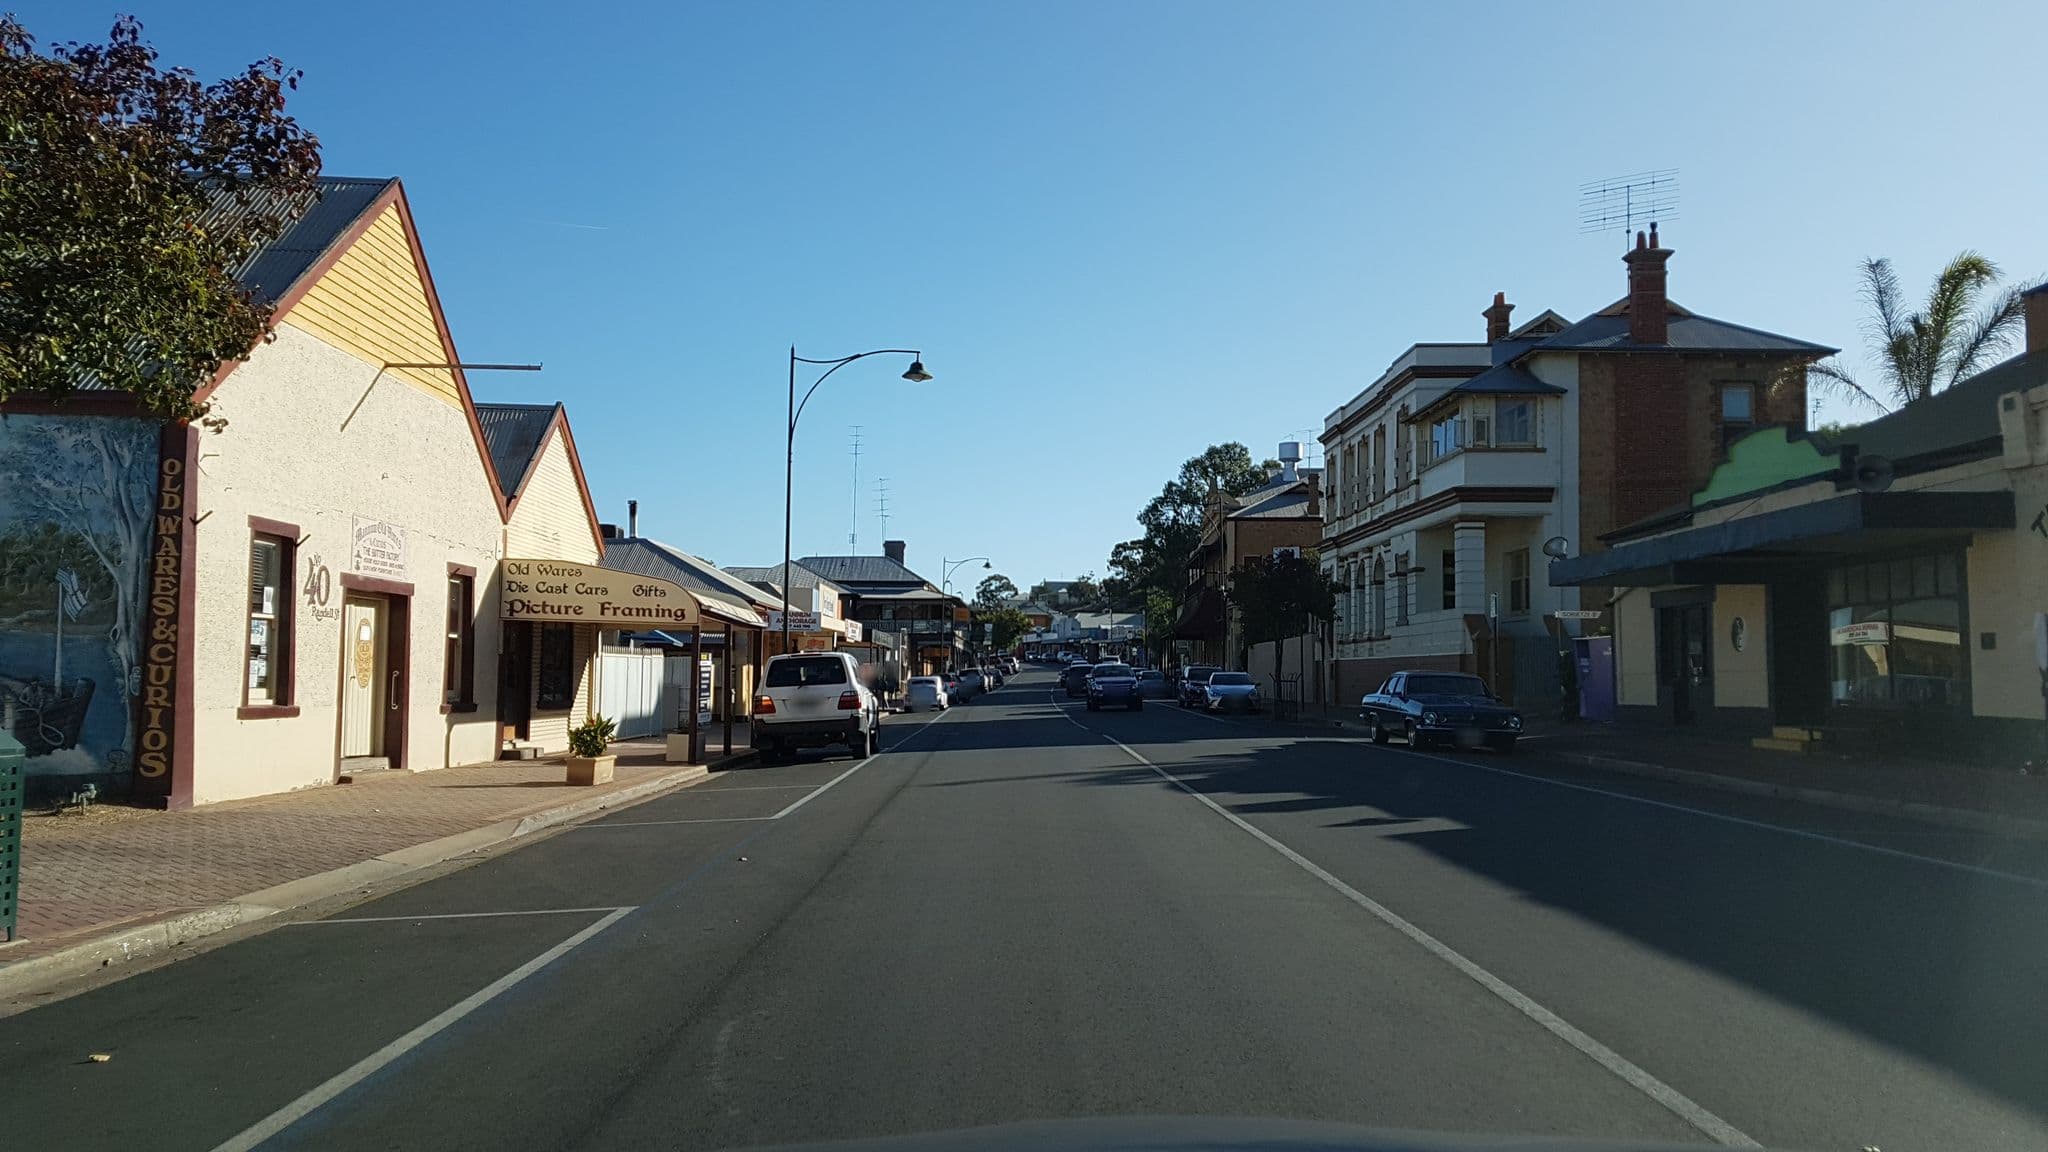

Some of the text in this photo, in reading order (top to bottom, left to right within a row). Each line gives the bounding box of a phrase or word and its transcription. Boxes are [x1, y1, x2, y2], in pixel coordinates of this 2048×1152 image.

[162, 457, 182, 510] OLD
[507, 562, 583, 577] Old Wares
[303, 556, 330, 606] 40
[504, 580, 667, 598] Die Cast Cars Gifts
[311, 606, 333, 622] Randell
[503, 598, 687, 621] Picture Framing
